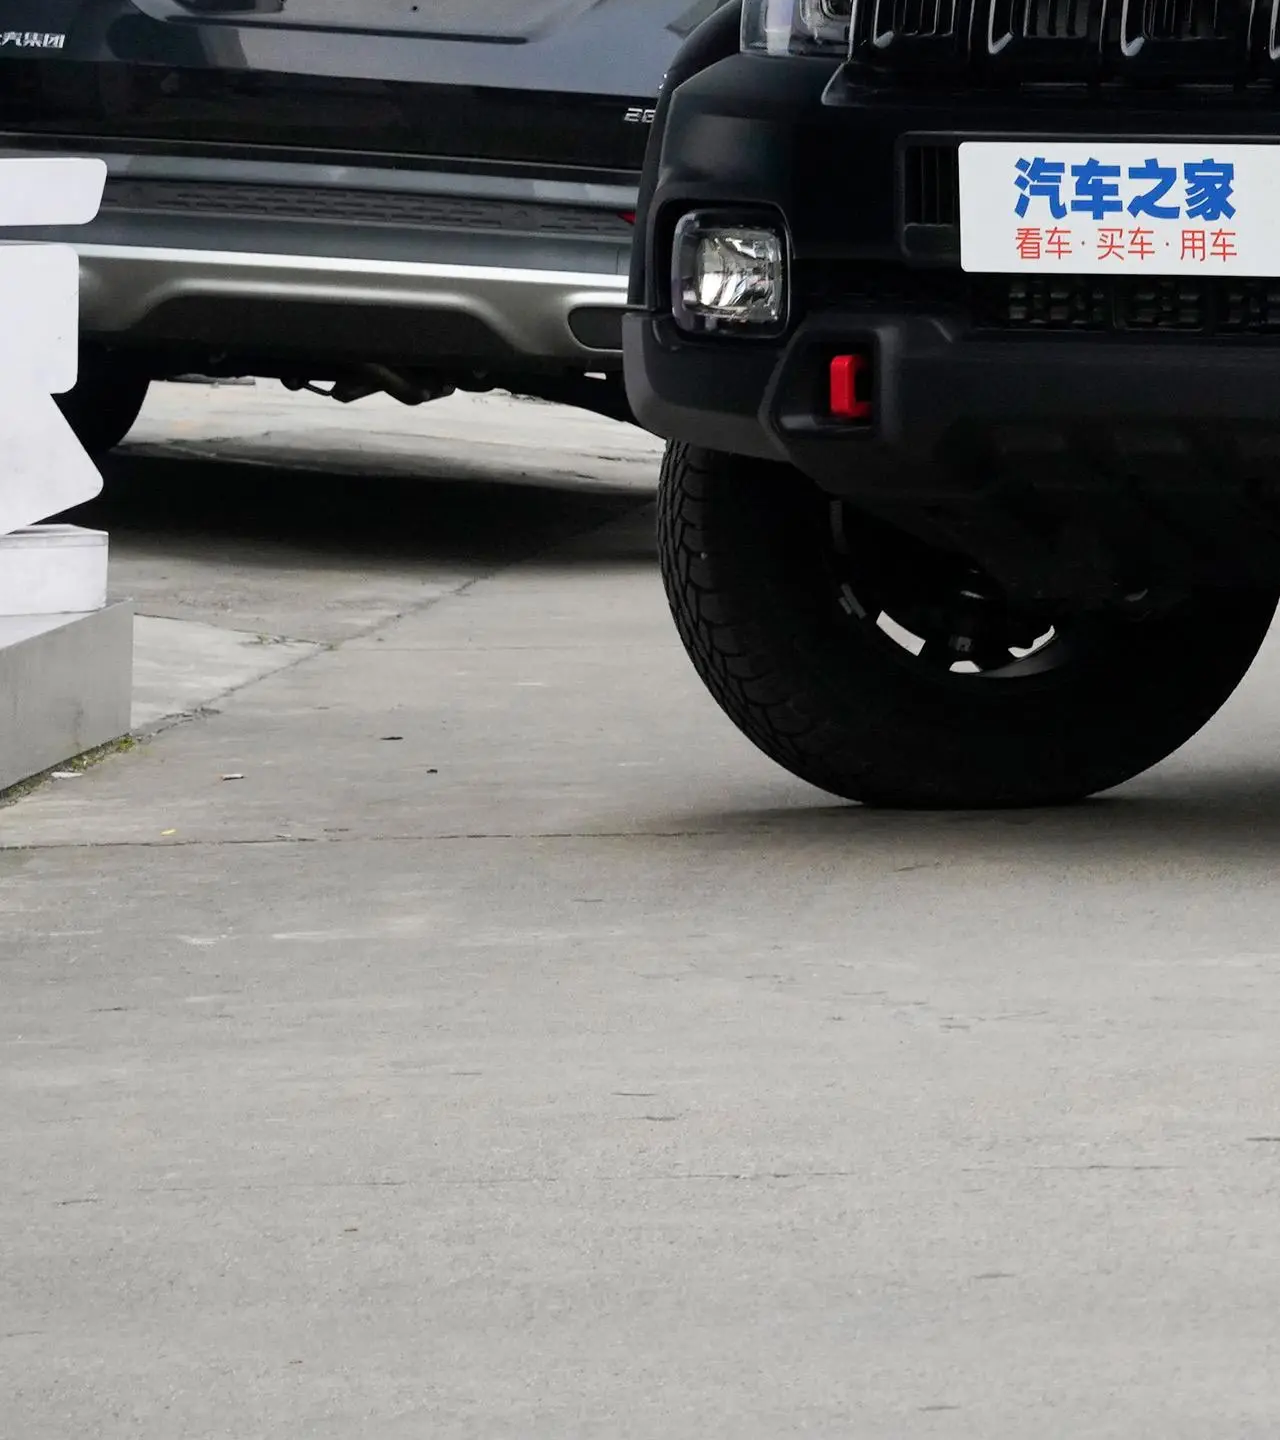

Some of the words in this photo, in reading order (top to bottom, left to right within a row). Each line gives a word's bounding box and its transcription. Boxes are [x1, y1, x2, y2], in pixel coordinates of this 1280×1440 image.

[0, 31, 65, 49] 汽集团
[1013, 157, 1237, 221] 汽车之家
